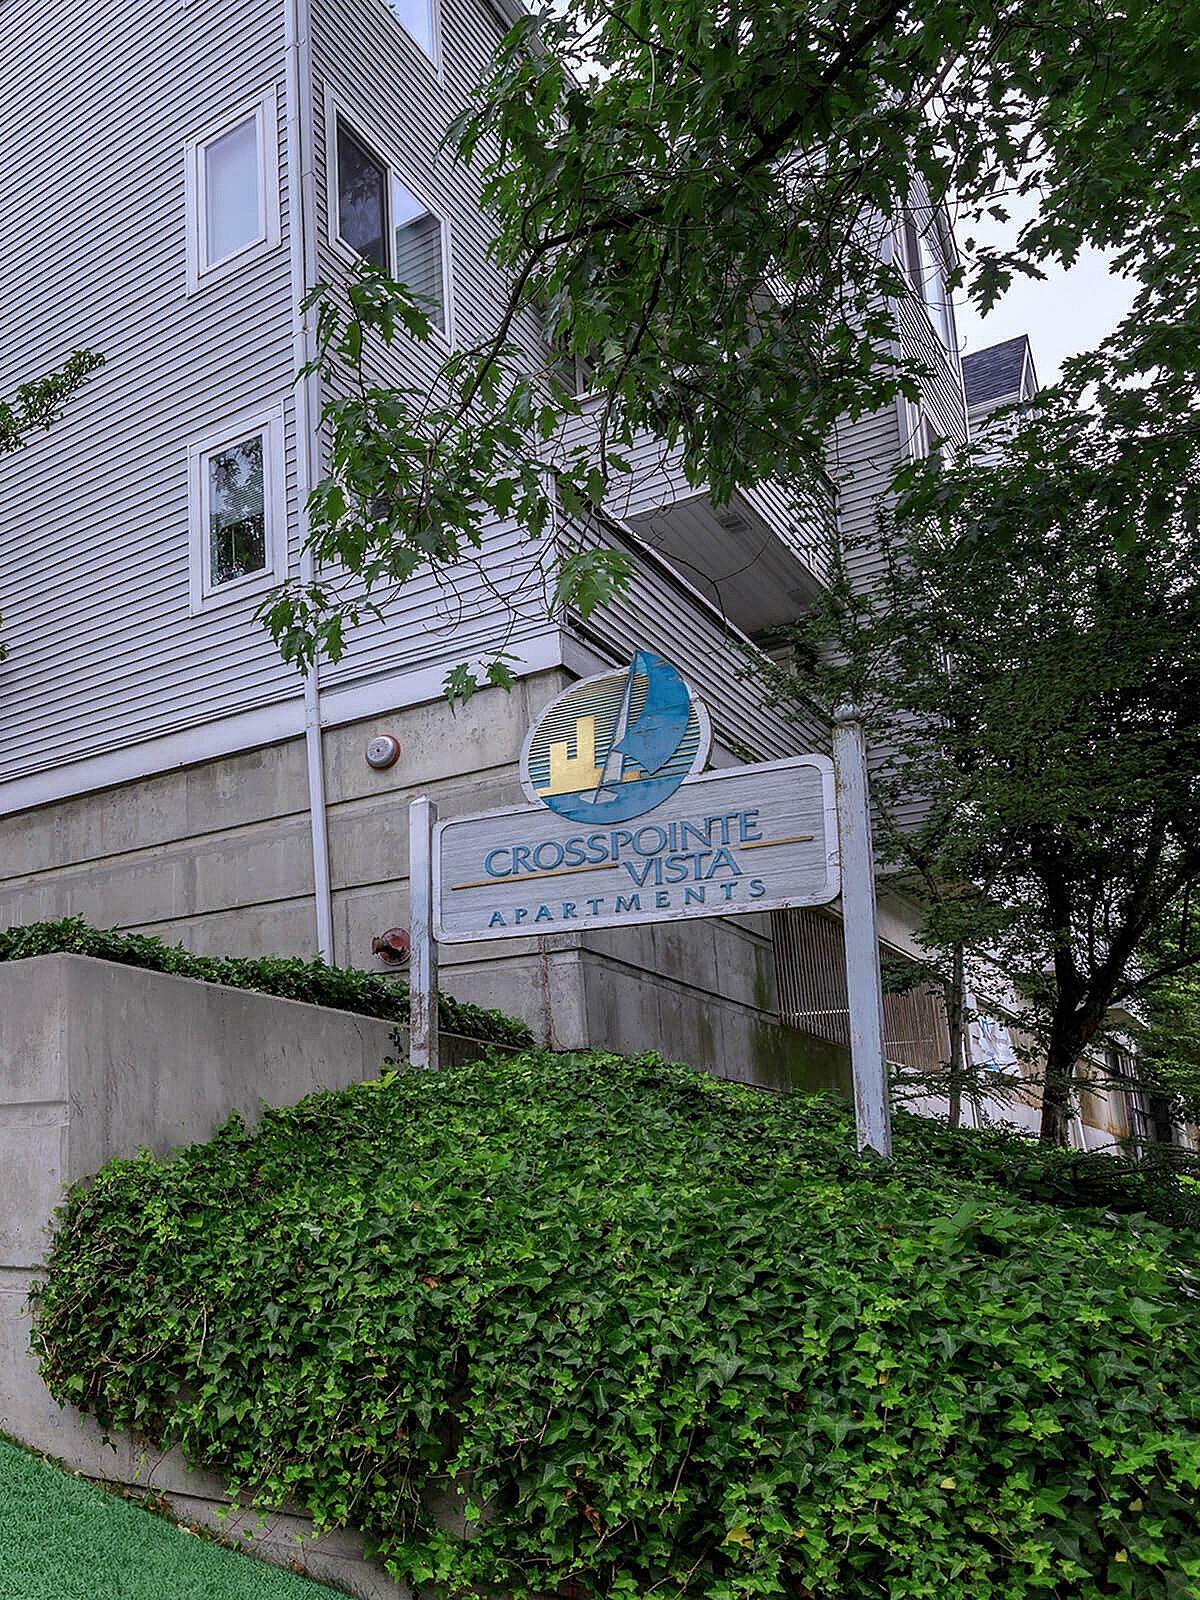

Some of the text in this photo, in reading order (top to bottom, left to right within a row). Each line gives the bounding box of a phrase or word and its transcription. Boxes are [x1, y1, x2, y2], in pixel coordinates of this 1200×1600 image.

[483, 808, 763, 877] CROSSPOINTE
[623, 847, 744, 887] VISTA
[487, 879, 766, 928] APARTMENTS
